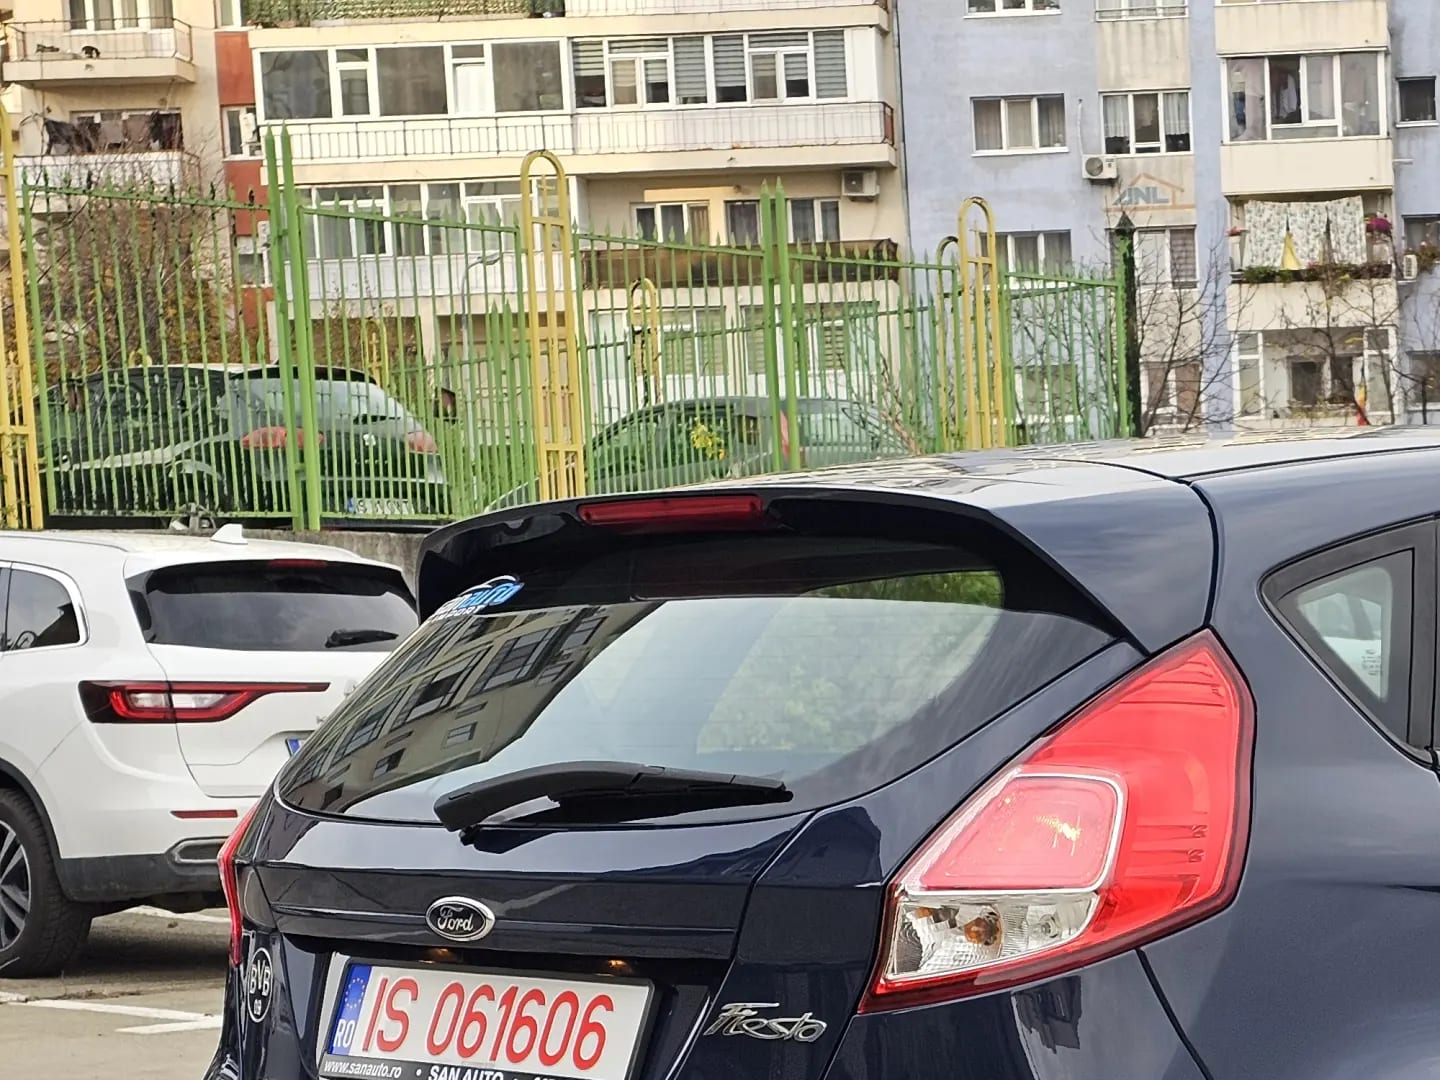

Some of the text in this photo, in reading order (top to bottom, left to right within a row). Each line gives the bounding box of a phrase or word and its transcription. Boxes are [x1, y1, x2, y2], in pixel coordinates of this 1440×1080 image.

[1112, 186, 1169, 206] ANL
[437, 905, 474, 931] Ford
[249, 959, 271, 996] BVB
[332, 1018, 356, 1048] RO
[362, 977, 614, 1071] IS 061606
[703, 1002, 827, 1042] Fiesta
[323, 1060, 402, 1079] www.sanauto.ro
